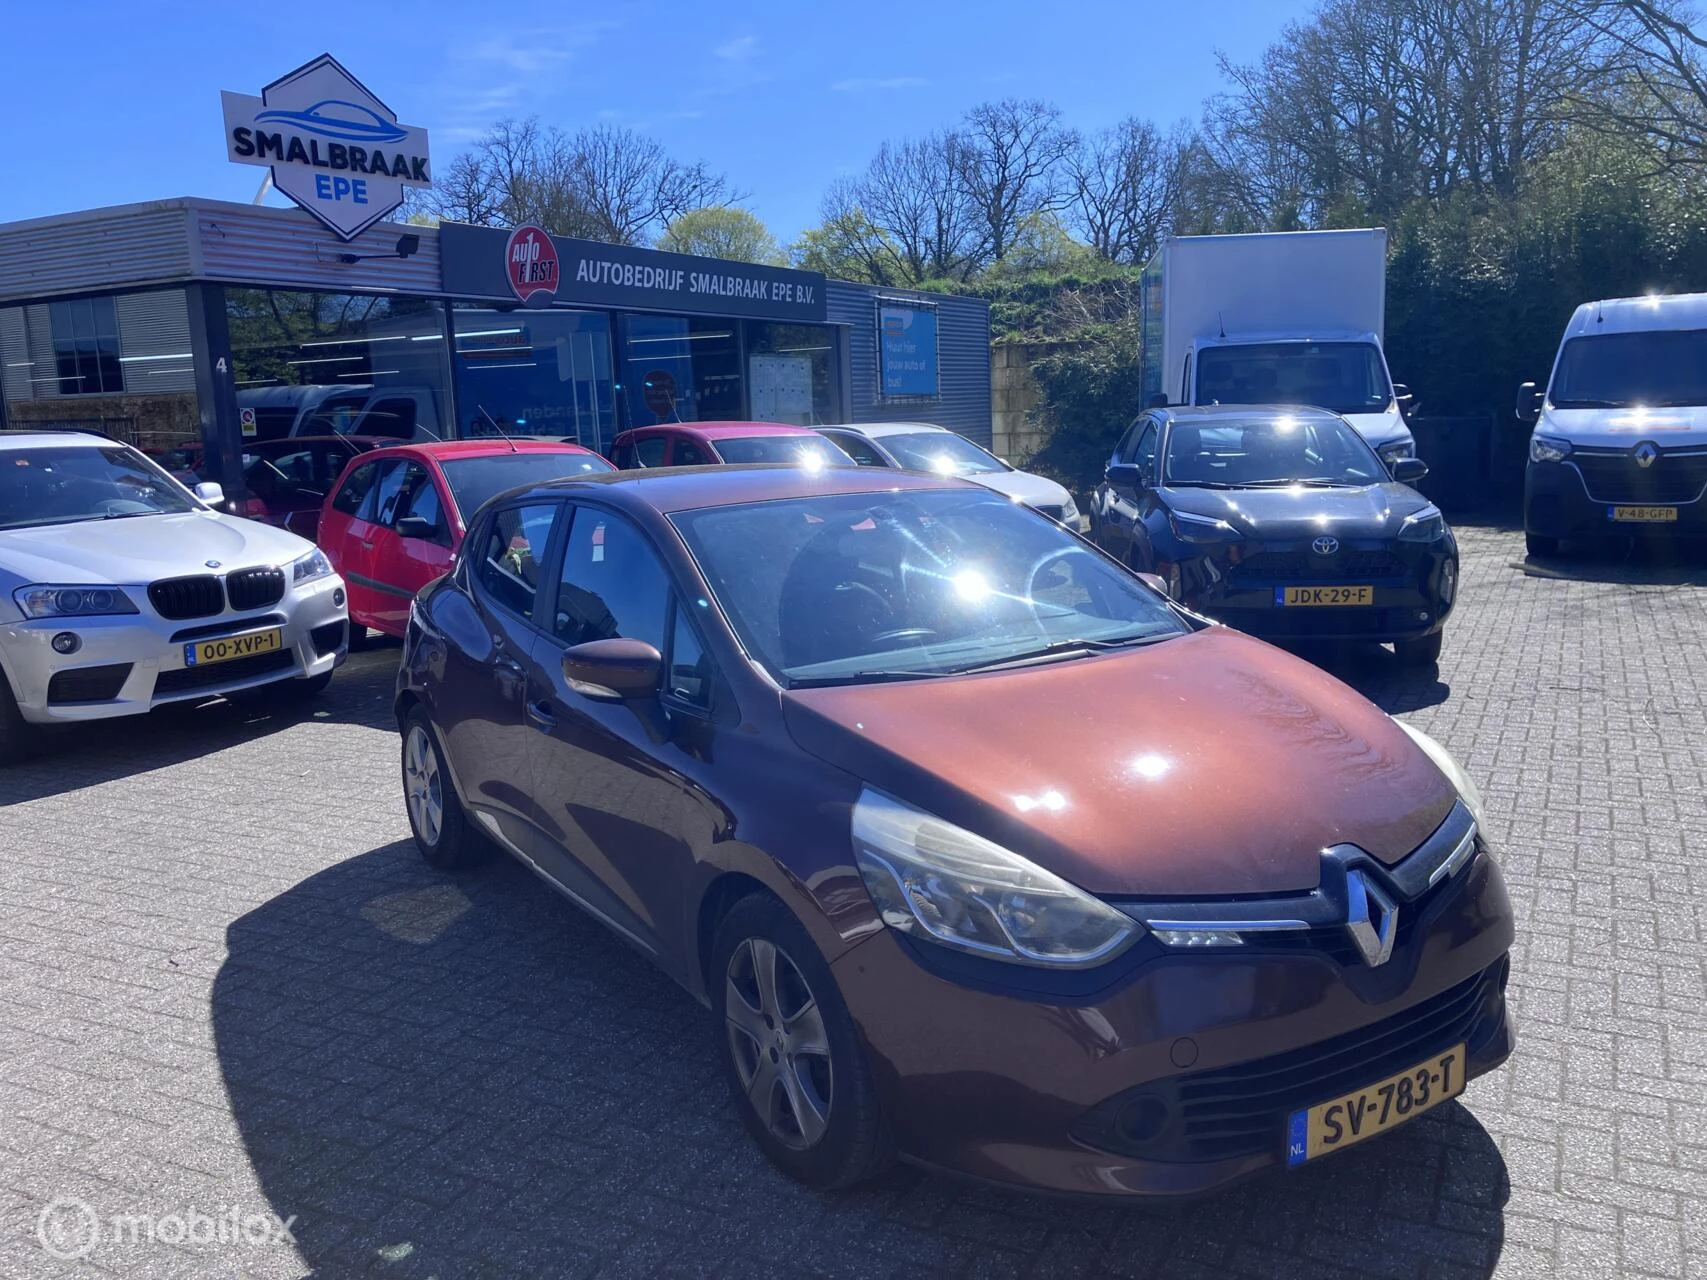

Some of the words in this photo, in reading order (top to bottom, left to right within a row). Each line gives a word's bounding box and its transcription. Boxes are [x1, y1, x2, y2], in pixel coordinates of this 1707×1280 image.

[232, 126, 430, 182] SMALBRAAK
[315, 173, 369, 204] EPE
[517, 259, 555, 284] FIRST
[576, 258, 684, 291] AUTOBEDRIJF
[689, 272, 768, 300] SMALBRAAK
[772, 282, 793, 302] EPE
[796, 285, 815, 304] B.V.
[215, 356, 228, 373] 4
[1290, 588, 1367, 603] JDK-29-F
[203, 633, 274, 659] 00-XVP-1
[1323, 1054, 1456, 1144] SV-783-T
[1290, 1142, 1305, 1156] NL
